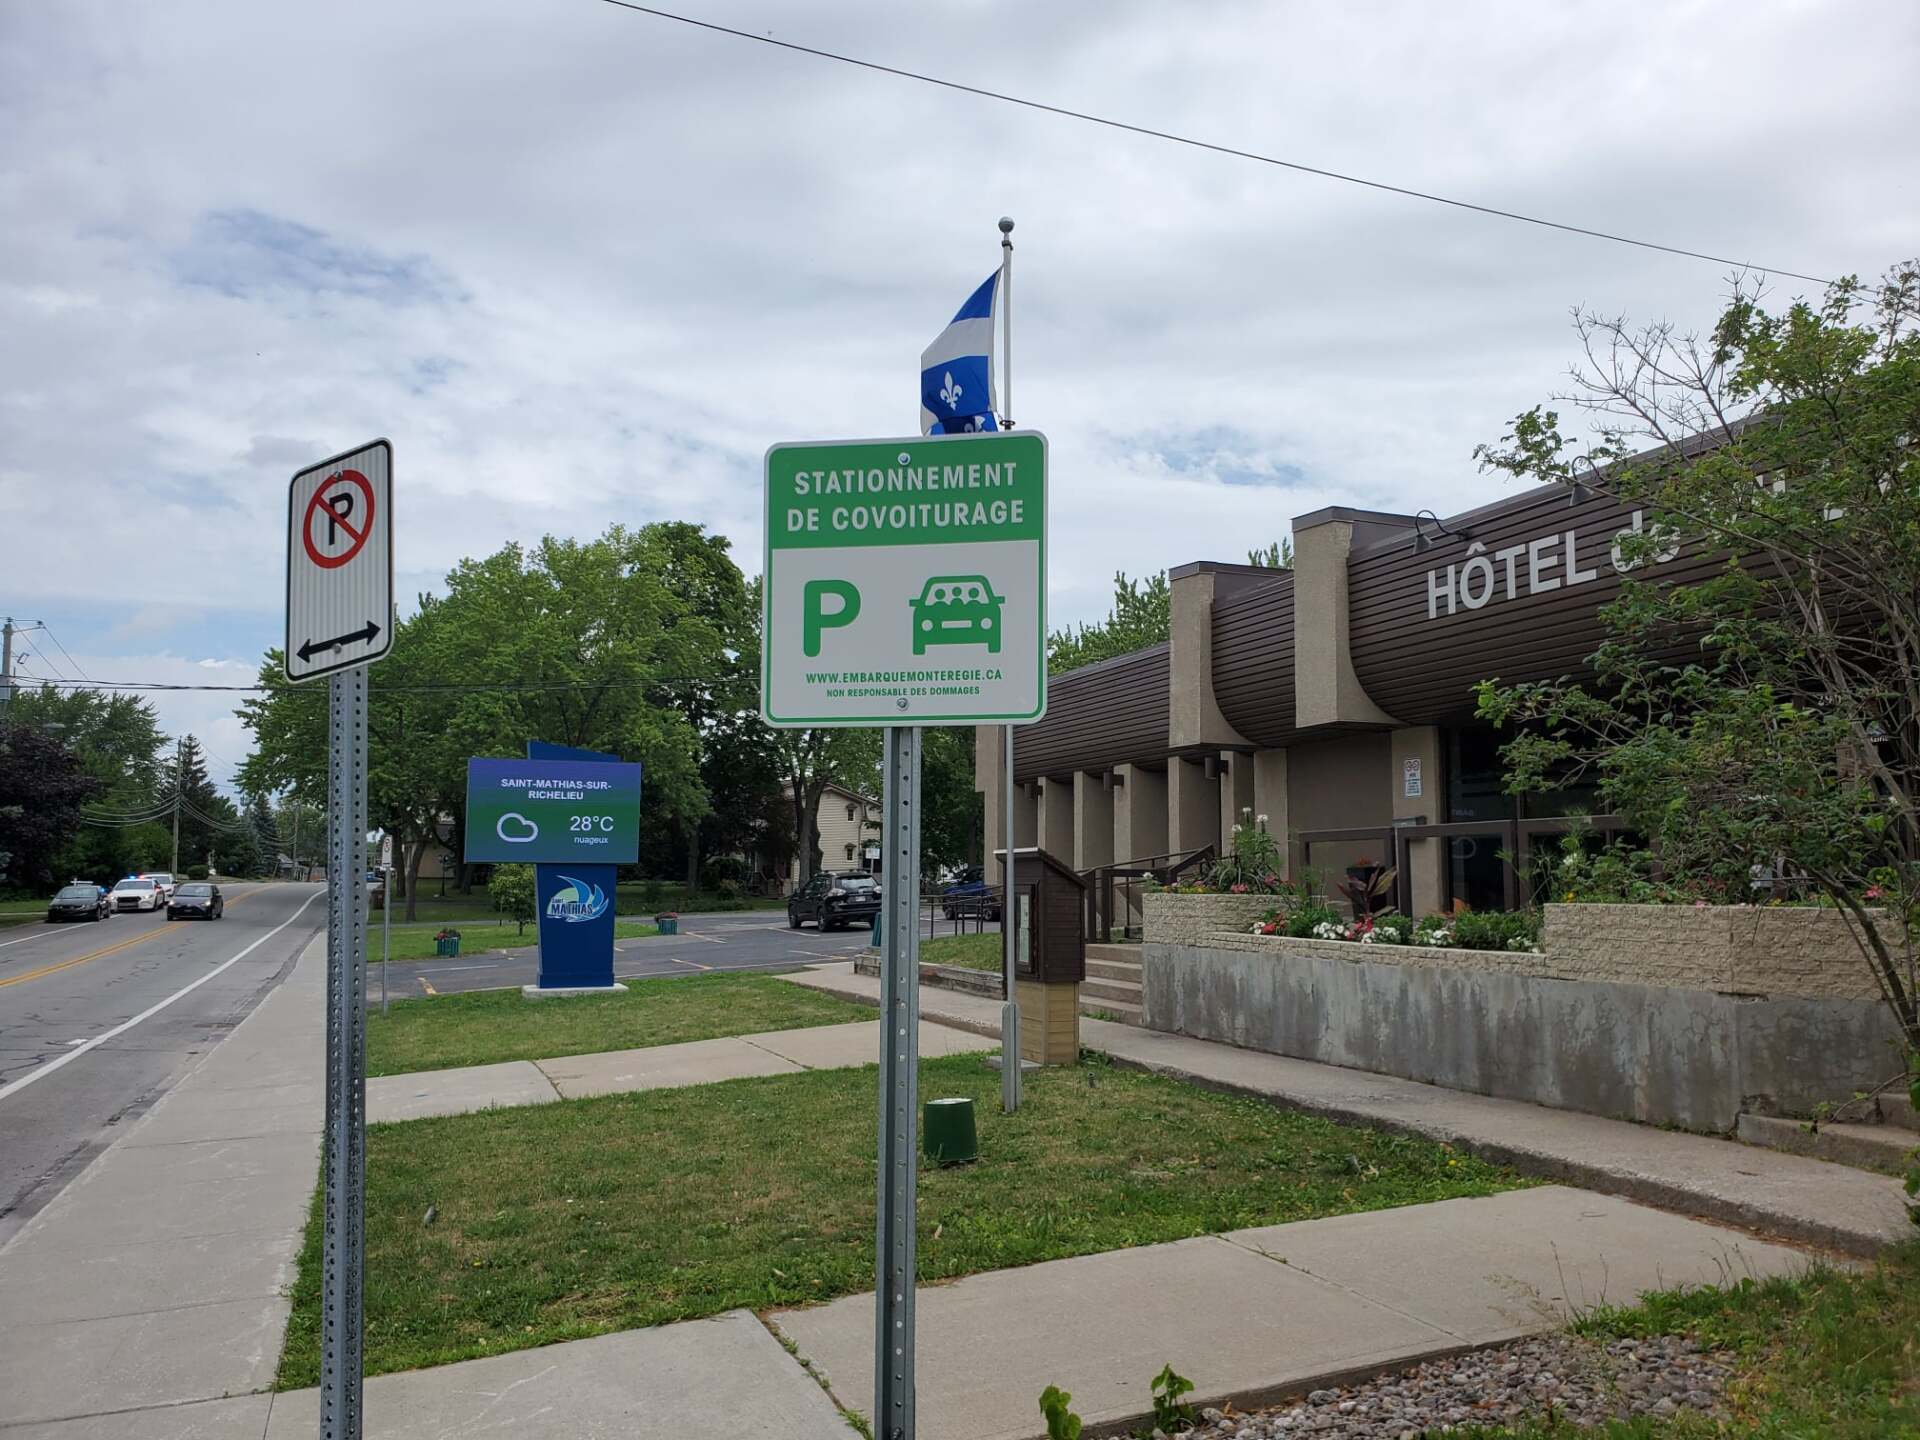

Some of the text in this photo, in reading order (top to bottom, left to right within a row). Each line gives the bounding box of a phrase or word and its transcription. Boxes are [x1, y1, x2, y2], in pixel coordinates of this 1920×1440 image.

[794, 462, 1017, 495] STATIONNEMENT
[787, 500, 1024, 532] DE COVOITURAGE
[1427, 530, 1598, 620] HÔTEL
[803, 579, 861, 658] P
[806, 669, 1002, 684] WWW.EMBARQUEMONTEREGIE.CA
[827, 686, 980, 698] NON RESPONSABLE DES DOMMAGES
[501, 778, 612, 790] SAINT-MATHIAS-SUR-
[528, 790, 584, 800] RICHELIEU
[570, 816, 614, 832] 28°C
[574, 837, 609, 846] nuageux
[551, 903, 593, 915] MATHIAS
